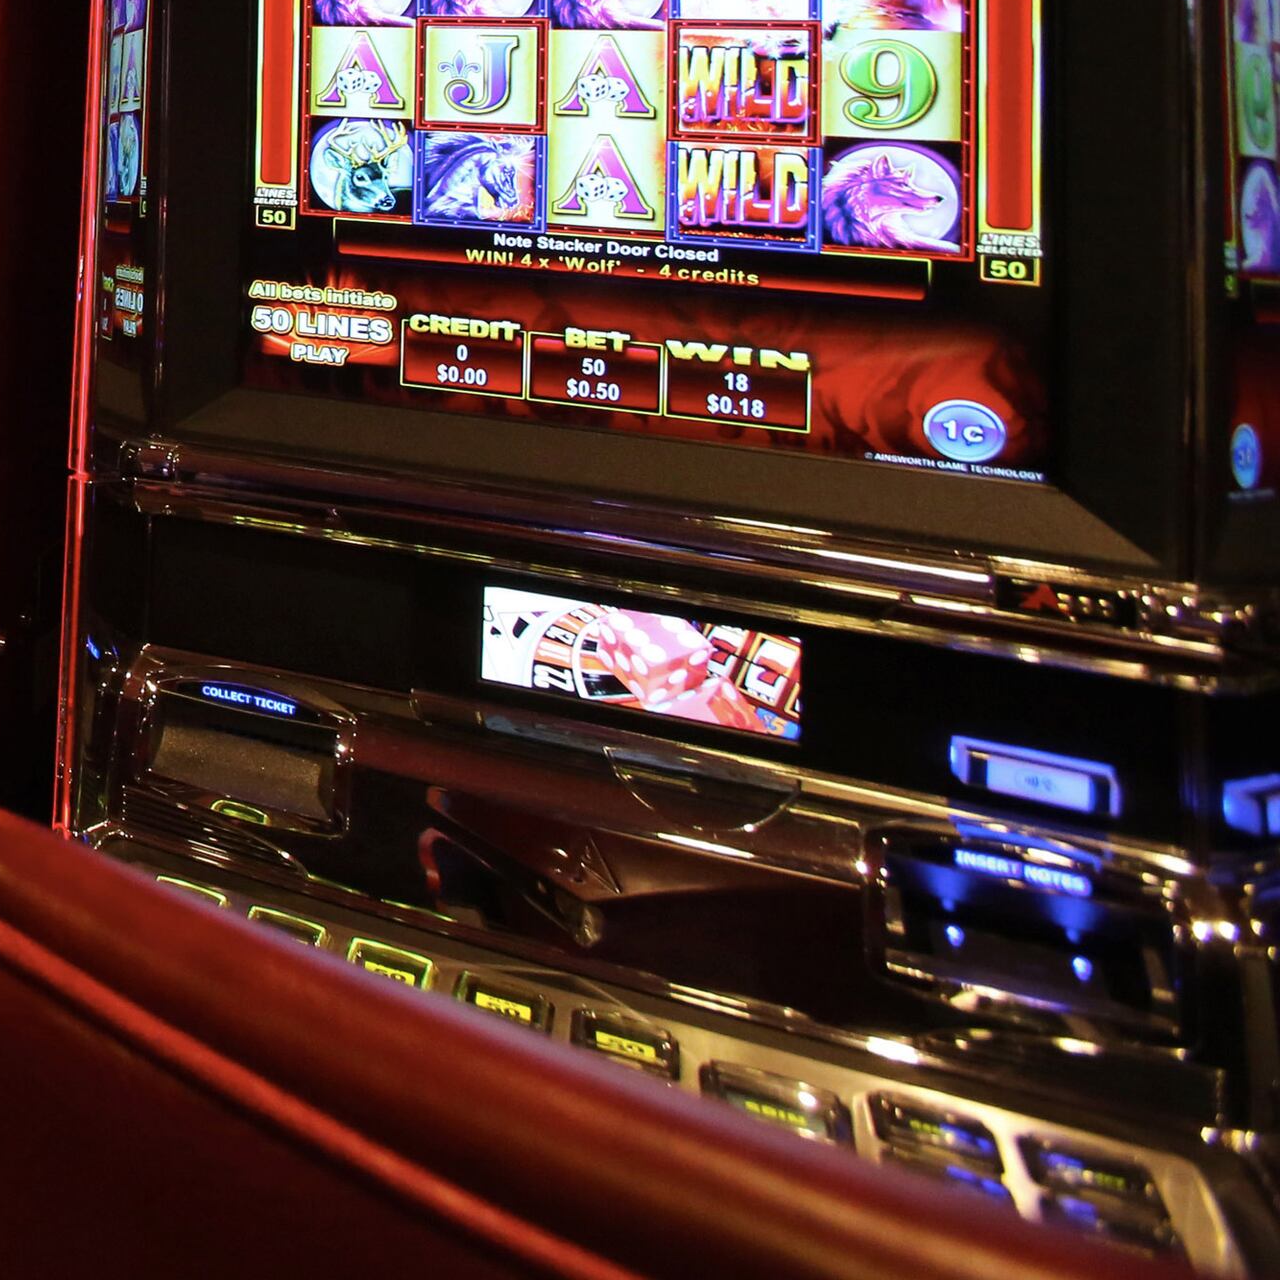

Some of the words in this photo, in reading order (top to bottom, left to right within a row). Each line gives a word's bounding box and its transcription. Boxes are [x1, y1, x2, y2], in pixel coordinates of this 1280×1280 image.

[315, 30, 405, 110] A
[443, 34, 520, 115] J
[553, 34, 657, 119] A
[680, 45, 809, 124] WILD
[839, 38, 938, 130] 9
[552, 134, 656, 220] A
[678, 147, 809, 228] WILD
[262, 210, 287, 225] 50
[493, 233, 533, 250] Note
[537, 236, 601, 255] Stacker
[606, 241, 651, 258] Door
[654, 244, 719, 263] Closed
[465, 248, 515, 267] WIN!
[521, 253, 533, 267] 4
[539, 258, 550, 269] x
[659, 265, 672, 279] 4
[677, 266, 759, 286] credits
[990, 261, 1026, 279] 50
[250, 282, 276, 298] All
[281, 285, 322, 302] bets
[327, 289, 395, 308] initiate
[253, 308, 291, 332] 50
[297, 312, 390, 342] LINES
[409, 313, 521, 343] CREDIT
[565, 327, 631, 353] BET
[293, 344, 347, 363] PLAY
[456, 345, 468, 361] 0
[581, 357, 606, 377] 50
[665, 341, 811, 372] WIN
[436, 364, 487, 387] $0.00
[566, 378, 620, 402] $0.50
[724, 372, 748, 392] 18
[706, 393, 765, 418] $0.18
[874, 452, 935, 468] AINSWORTH
[936, 459, 967, 472] GAME
[970, 464, 1045, 481] TECHNOLOGY
[202, 685, 251, 705] COLLECT
[254, 696, 296, 715] TICKET
[955, 849, 1020, 881] INSERT
[1023, 863, 1092, 897] NOTES
